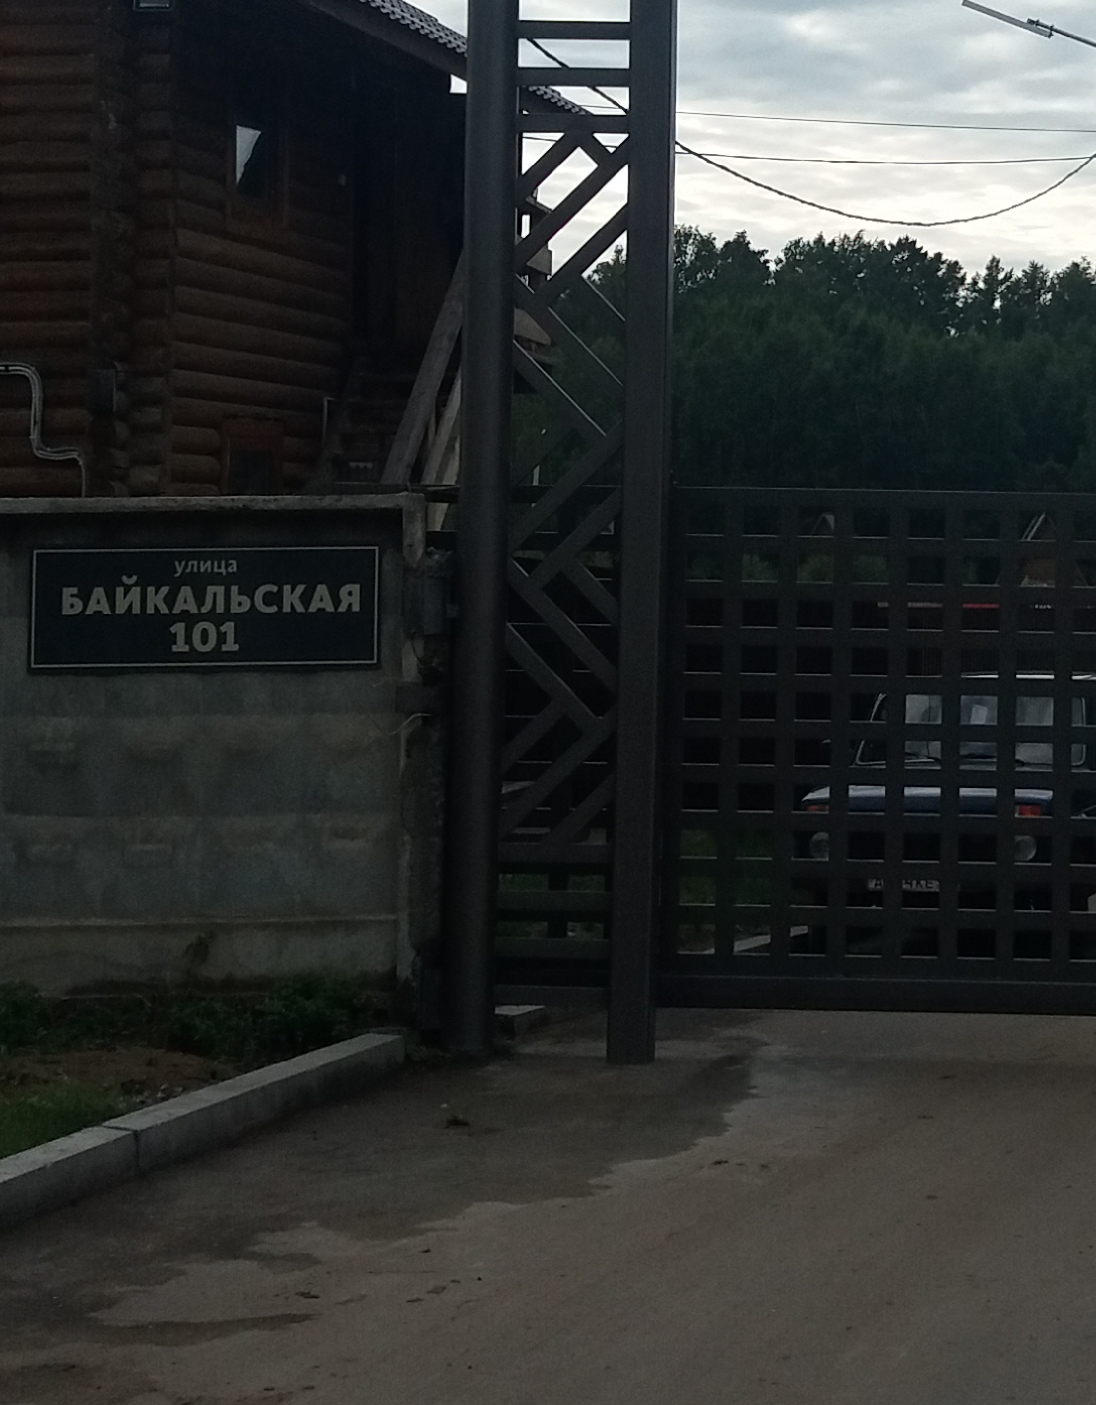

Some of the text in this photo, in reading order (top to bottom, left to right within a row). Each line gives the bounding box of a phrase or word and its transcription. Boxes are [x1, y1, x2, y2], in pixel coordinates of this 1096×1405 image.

[174, 559, 238, 577] улица
[61, 574, 361, 615] БАЙКАЛЬСКАЯ
[169, 622, 240, 652] 101
